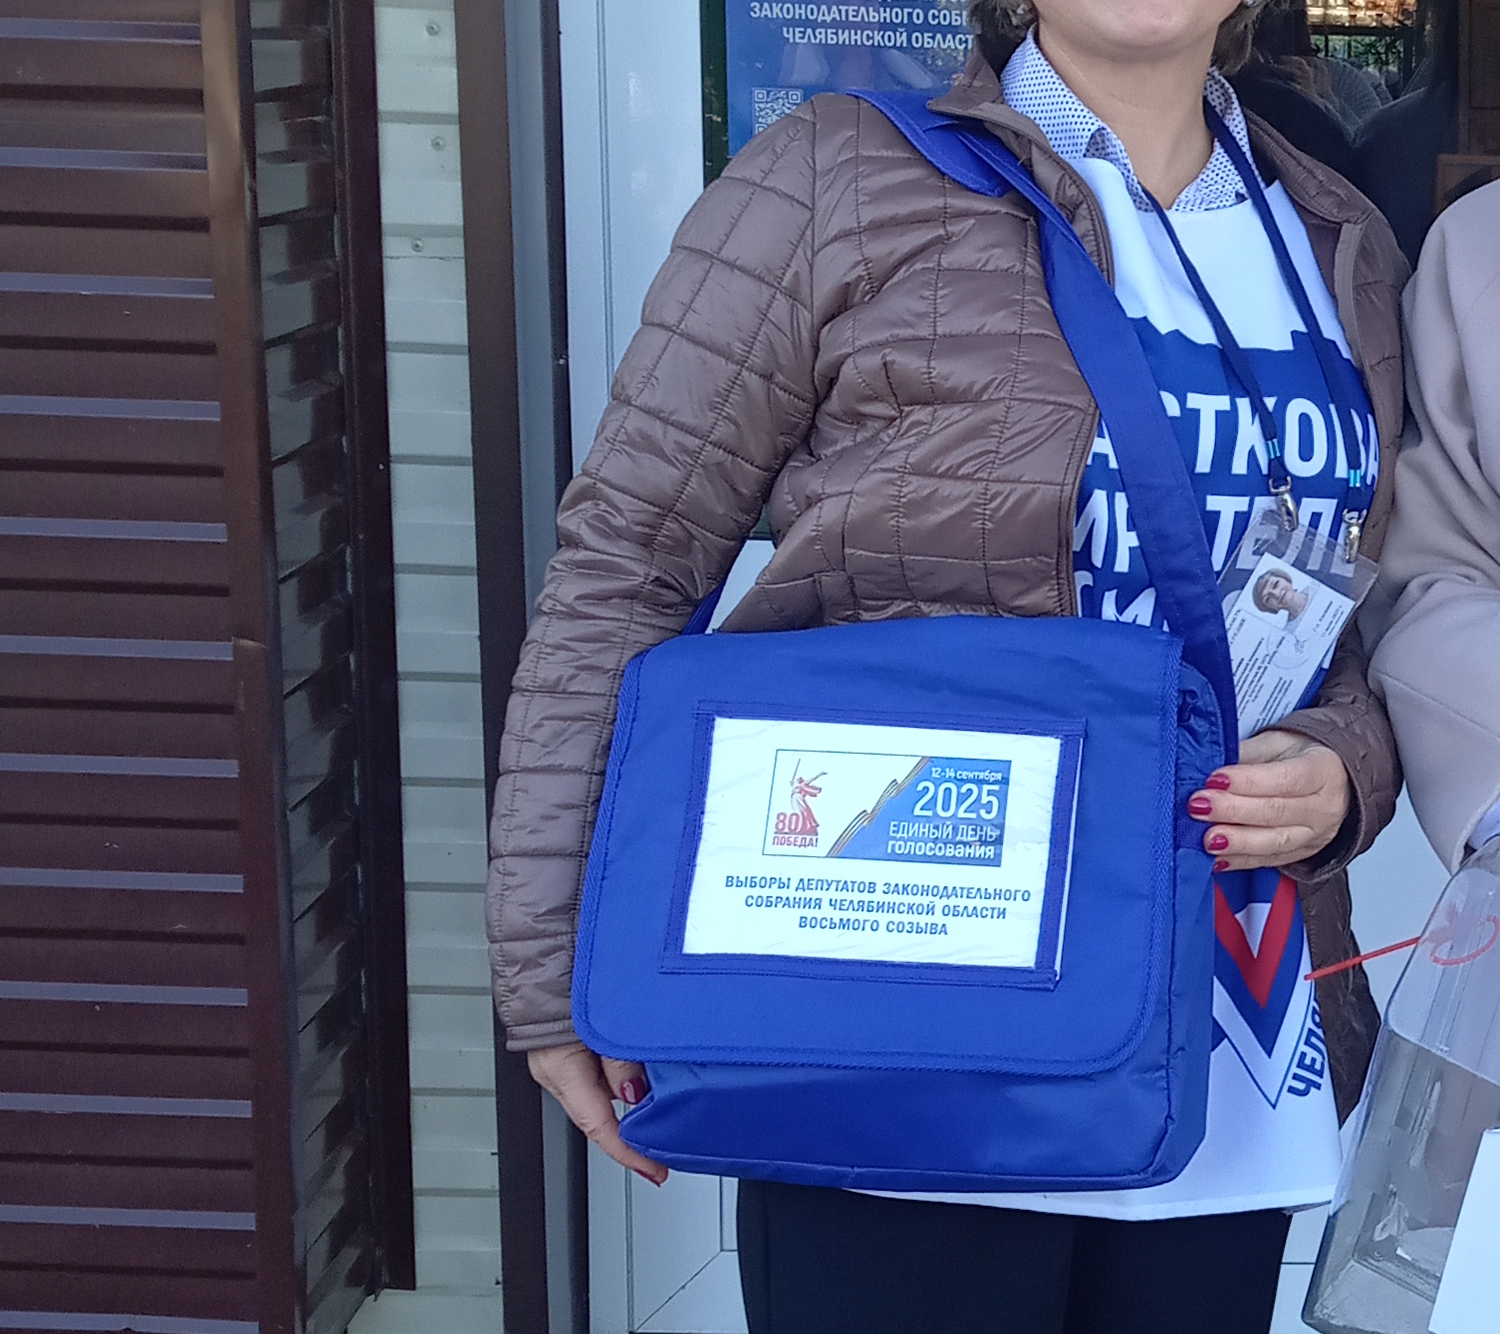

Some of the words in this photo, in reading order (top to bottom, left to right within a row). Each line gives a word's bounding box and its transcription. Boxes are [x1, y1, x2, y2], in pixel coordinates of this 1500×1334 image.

[750, 2, 924, 25] ЗАКОНОДАТЕЛЬНОГО
[783, 27, 907, 48] ЧЕЛЯБИНСКОЙ
[931, 767, 955, 780] 12-14
[956, 769, 1002, 782] сентября
[913, 782, 999, 819] 2025
[775, 812, 799, 833] 80
[889, 820, 953, 839] ЕДИНЫЙ
[956, 825, 997, 843] ДЕНЬ
[773, 835, 818, 849] ПОБЕДА!
[725, 875, 791, 890] ВЫБОРЫ
[795, 878, 877, 895] ДЕПУТАТОВ
[882, 882, 1031, 902] ЗАКОНОДАТЕЛЬНОГО
[745, 895, 822, 910] СОБРАНИЯ
[828, 898, 936, 916] ЧЕЛЯБИНСКОЙ
[941, 904, 1006, 919] ОБЛАСТИ
[798, 916, 879, 932] ВОСЬМОГО
[886, 921, 948, 935] СОЗЫВА
